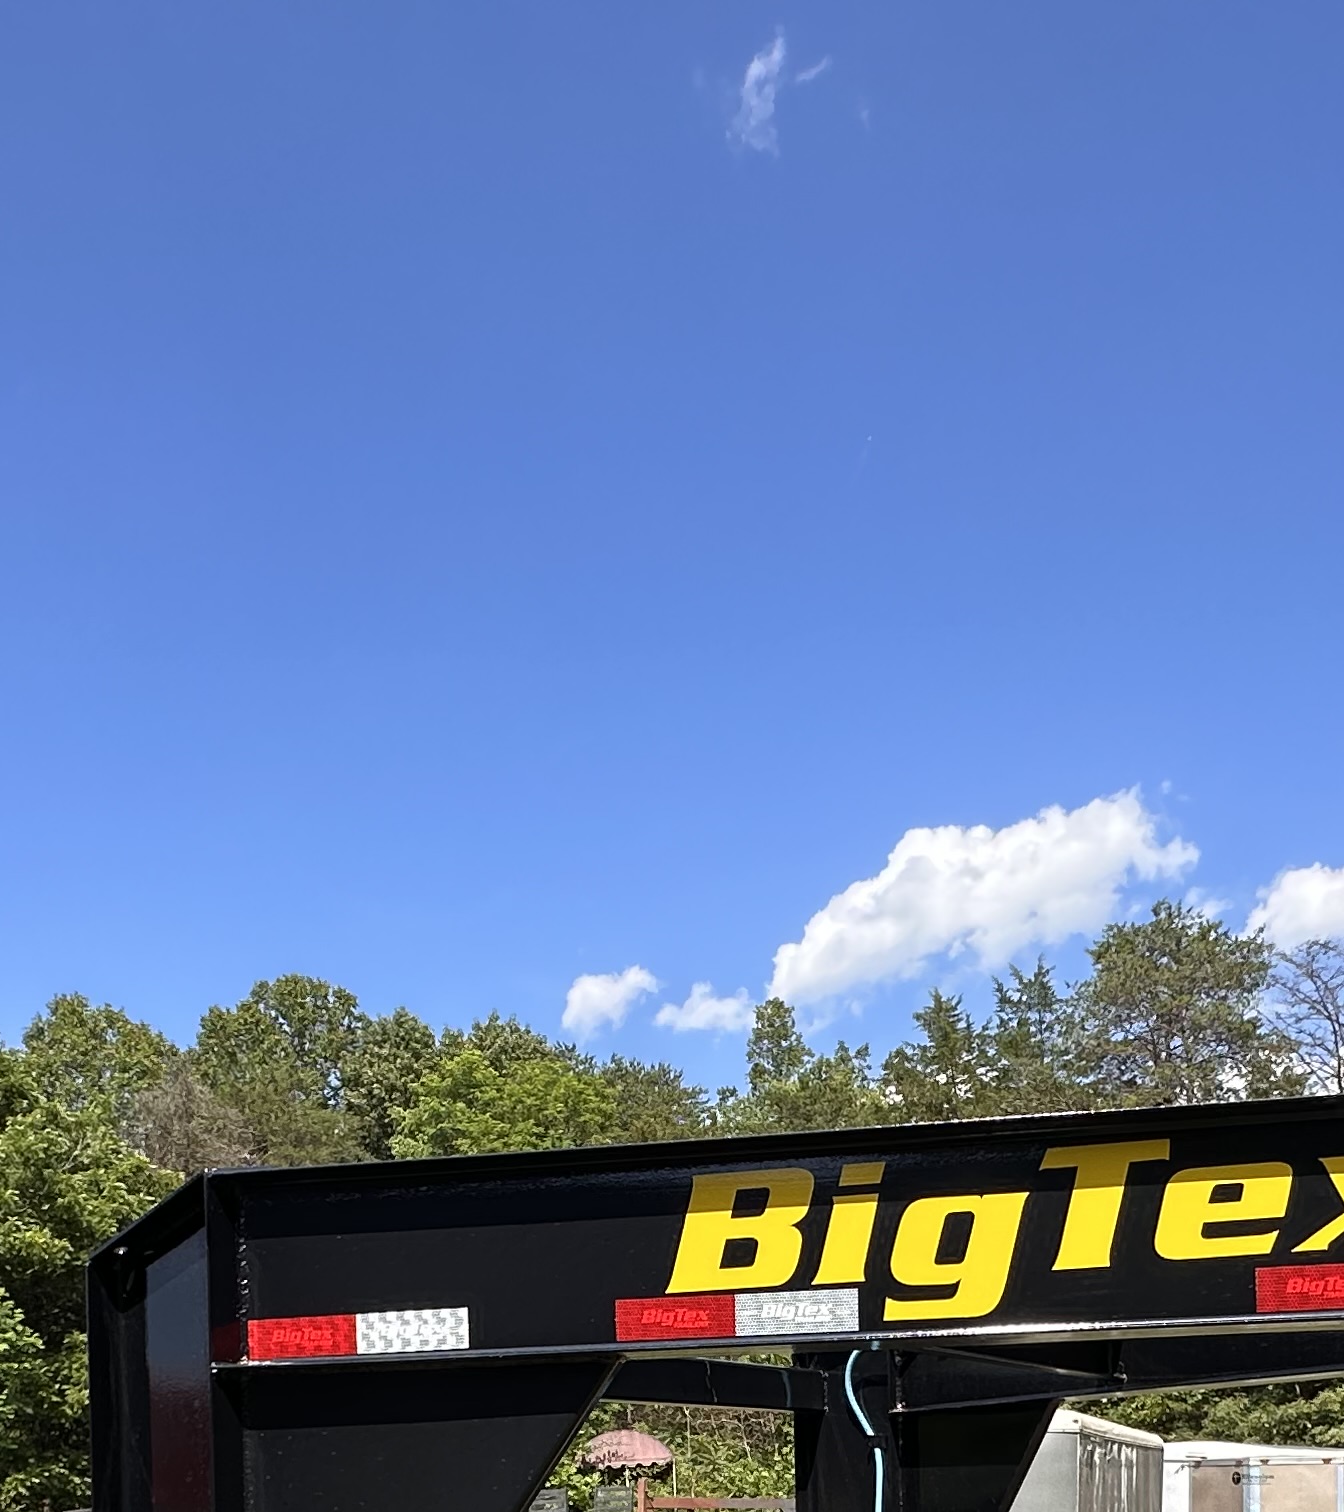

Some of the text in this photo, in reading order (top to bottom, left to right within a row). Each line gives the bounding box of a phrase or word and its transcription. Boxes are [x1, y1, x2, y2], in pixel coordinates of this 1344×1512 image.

[641, 1308, 709, 1327] BigTex
[761, 1302, 833, 1321] BigTex
[272, 1327, 334, 1344] BigTex
